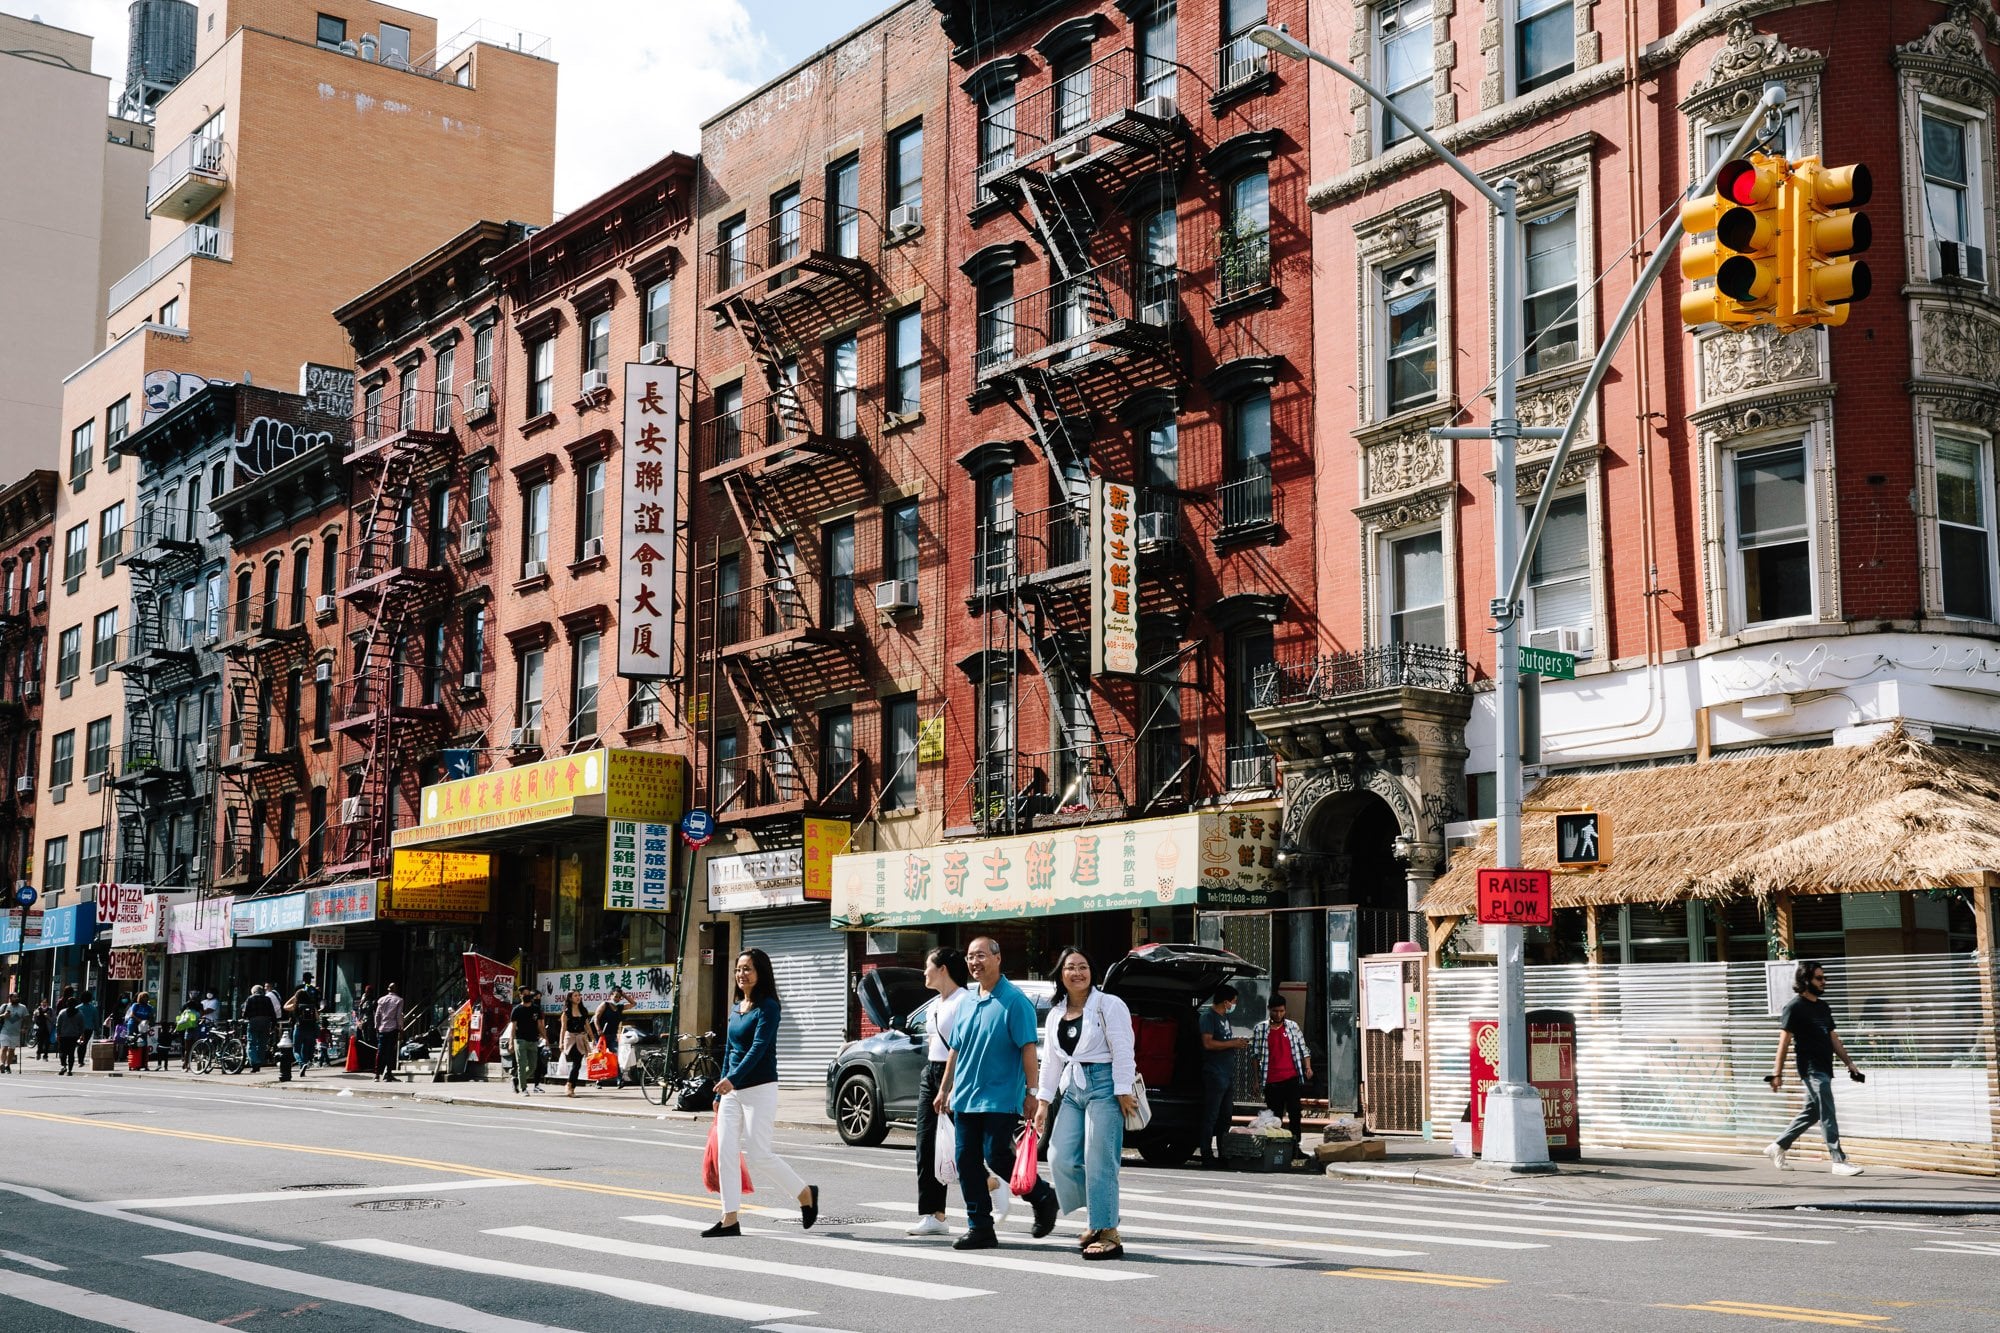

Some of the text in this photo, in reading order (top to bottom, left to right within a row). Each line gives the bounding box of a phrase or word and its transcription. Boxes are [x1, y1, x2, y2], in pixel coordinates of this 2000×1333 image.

[630, 381, 667, 658] 長安聯誼會大廈
[1109, 485, 1130, 616] 新奇士餅屋
[1520, 649, 1573, 674] Rutgers St
[394, 831, 412, 846] TRUE
[416, 825, 445, 841] BUDDHA
[448, 818, 478, 836] TEMPLE
[480, 813, 505, 830] CHINA
[508, 807, 533, 824] TOWN
[612, 821, 636, 908] 順昌雞鴨超市
[807, 824, 819, 884] 五金行
[1123, 829, 1136, 887] 冷熱飲品
[643, 823, 668, 910] 華盛旅遊巴士
[773, 857, 781, 876] &
[904, 835, 1100, 901] 新奇士餅屋
[120, 888, 143, 902] PIZZA
[714, 885, 728, 895] DOOR
[1489, 877, 1539, 893] RAISE
[122, 905, 137, 914] FRIED
[1083, 900, 1095, 909] 160
[1105, 897, 1143, 908] Broadway
[1492, 900, 1537, 915] PLOW
[44, 916, 56, 938] GO
[117, 914, 142, 923] CHICKEN
[158, 905, 166, 937] PIZZA
[560, 970, 648, 992] 順昌雞鴨超市
[584, 993, 602, 1002] CHICKEN
